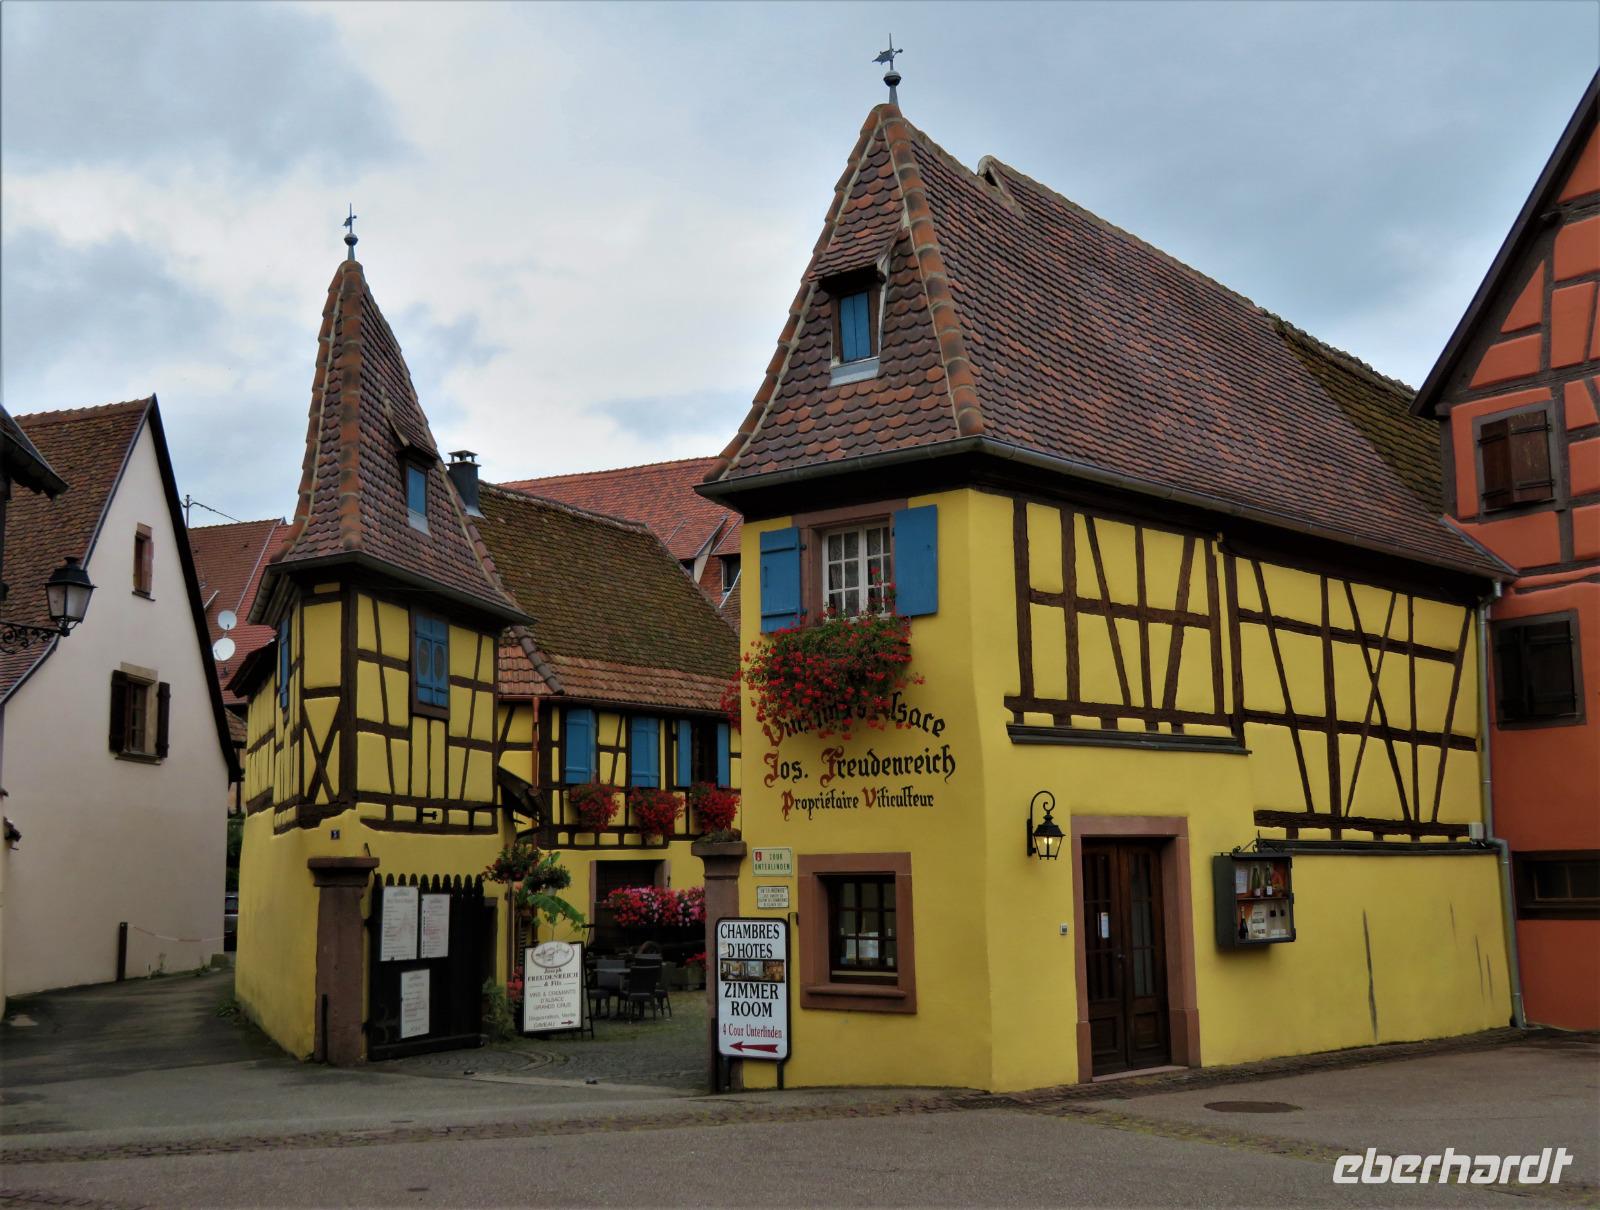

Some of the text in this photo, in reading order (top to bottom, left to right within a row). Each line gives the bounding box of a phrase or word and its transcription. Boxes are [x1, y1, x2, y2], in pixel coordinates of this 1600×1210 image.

[763, 744, 956, 788] Jos. Freudenreich
[781, 785, 935, 821] Propriétaire Viticulteur
[720, 923, 780, 940] CHAMBRES
[727, 943, 773, 959] D'HOTES
[724, 982, 779, 1000] ZIMMER
[730, 1001, 773, 1018] ROOM
[723, 1023, 783, 1039] 4 Cour Unterlinden
